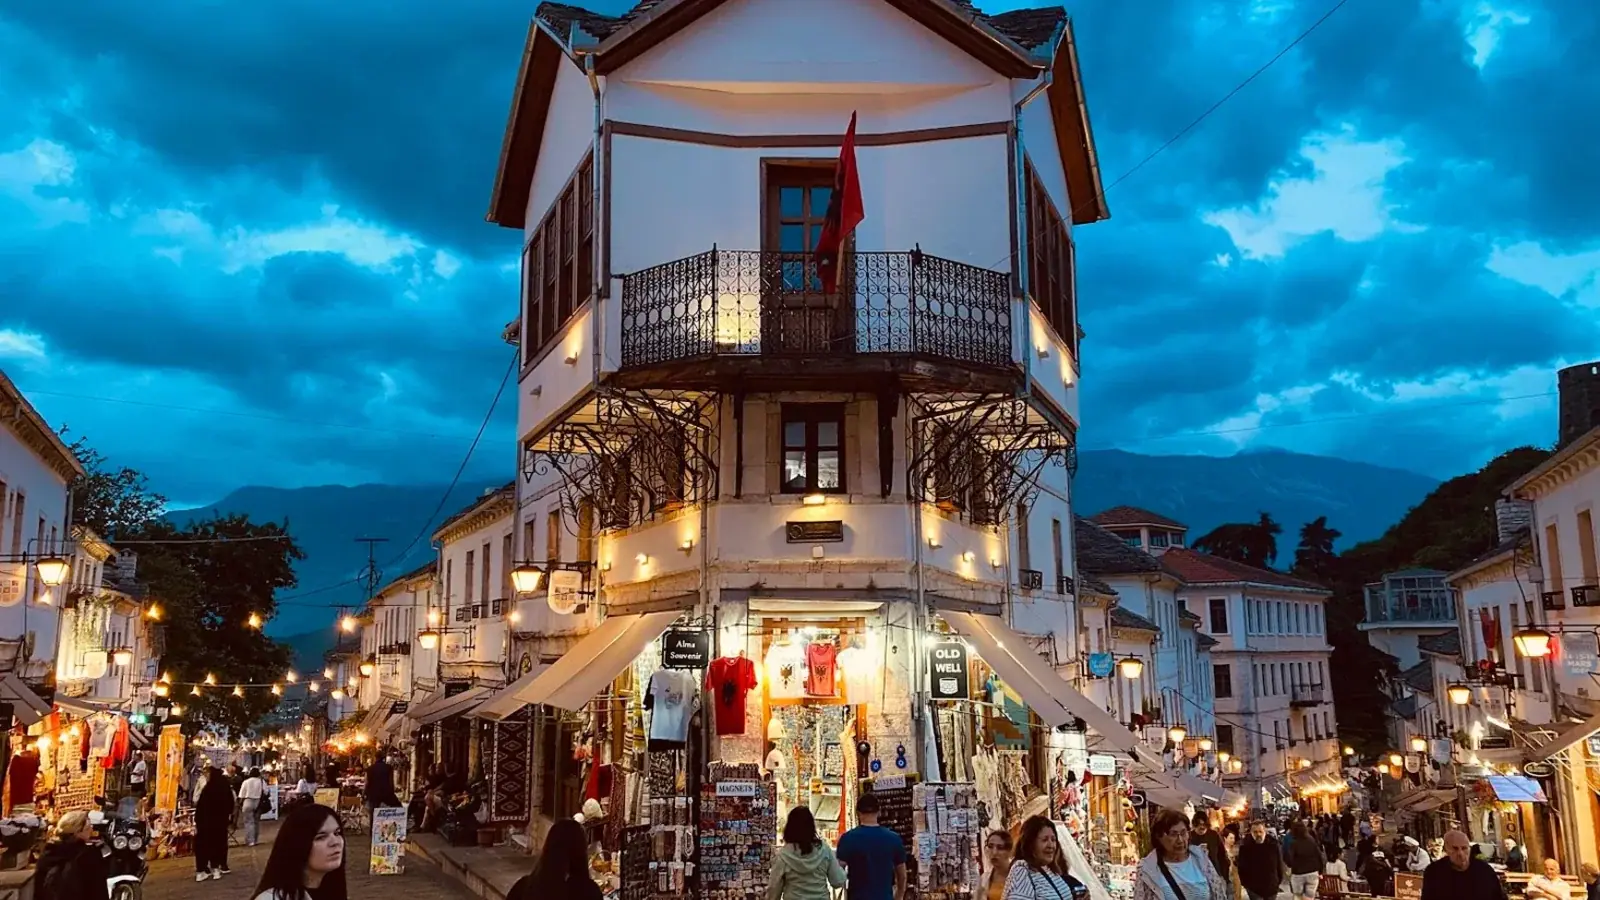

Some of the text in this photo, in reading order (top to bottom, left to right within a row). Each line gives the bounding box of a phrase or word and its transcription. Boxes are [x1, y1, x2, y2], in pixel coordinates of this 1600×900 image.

[676, 640, 695, 648] Alma
[670, 652, 702, 660] Souvenir
[935, 649, 960, 659] OLD
[935, 663, 962, 673] WELL
[718, 785, 753, 793] MAGNETS
